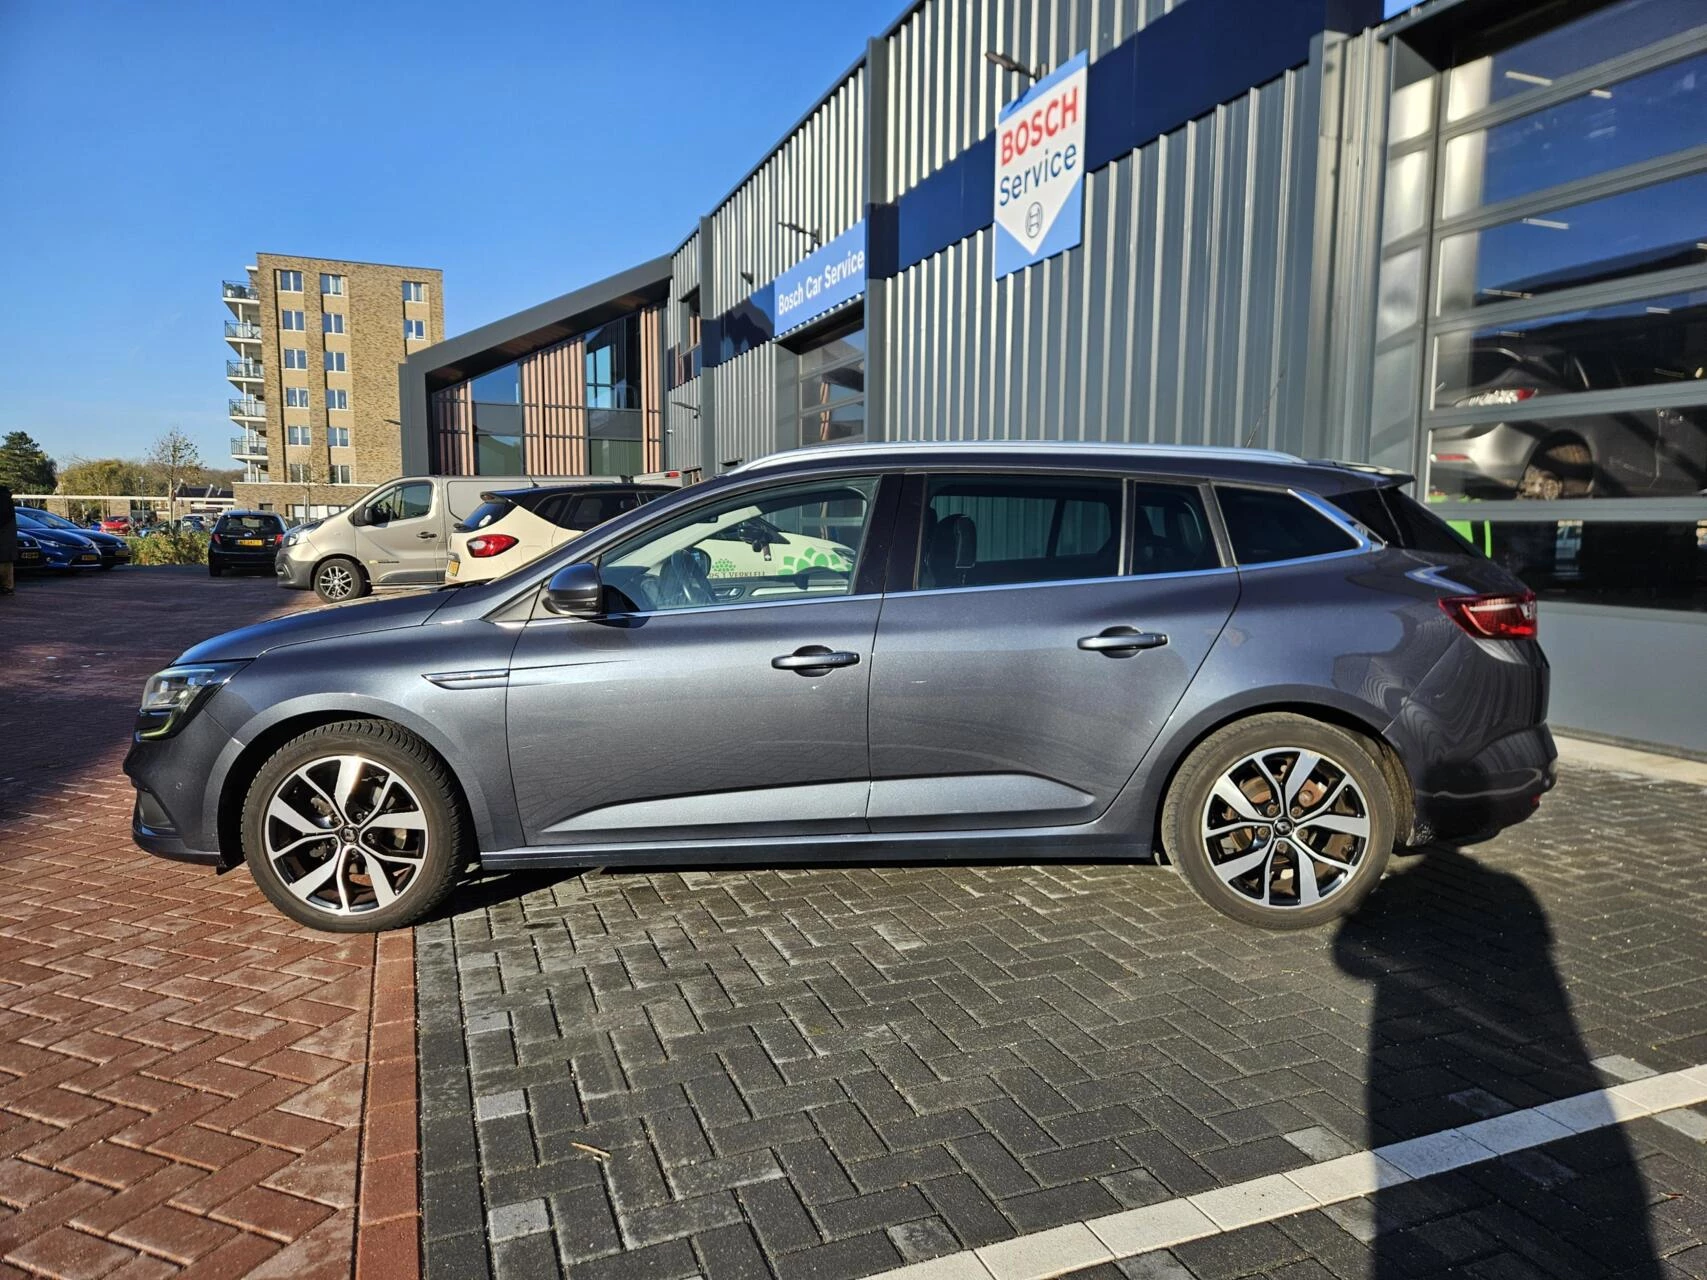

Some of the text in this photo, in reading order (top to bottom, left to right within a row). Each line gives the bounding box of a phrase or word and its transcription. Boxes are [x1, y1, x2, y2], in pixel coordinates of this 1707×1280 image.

[1001, 87, 1078, 167] BOSCH
[999, 143, 1077, 206] Service
[778, 249, 865, 317] Bosch Car Service
